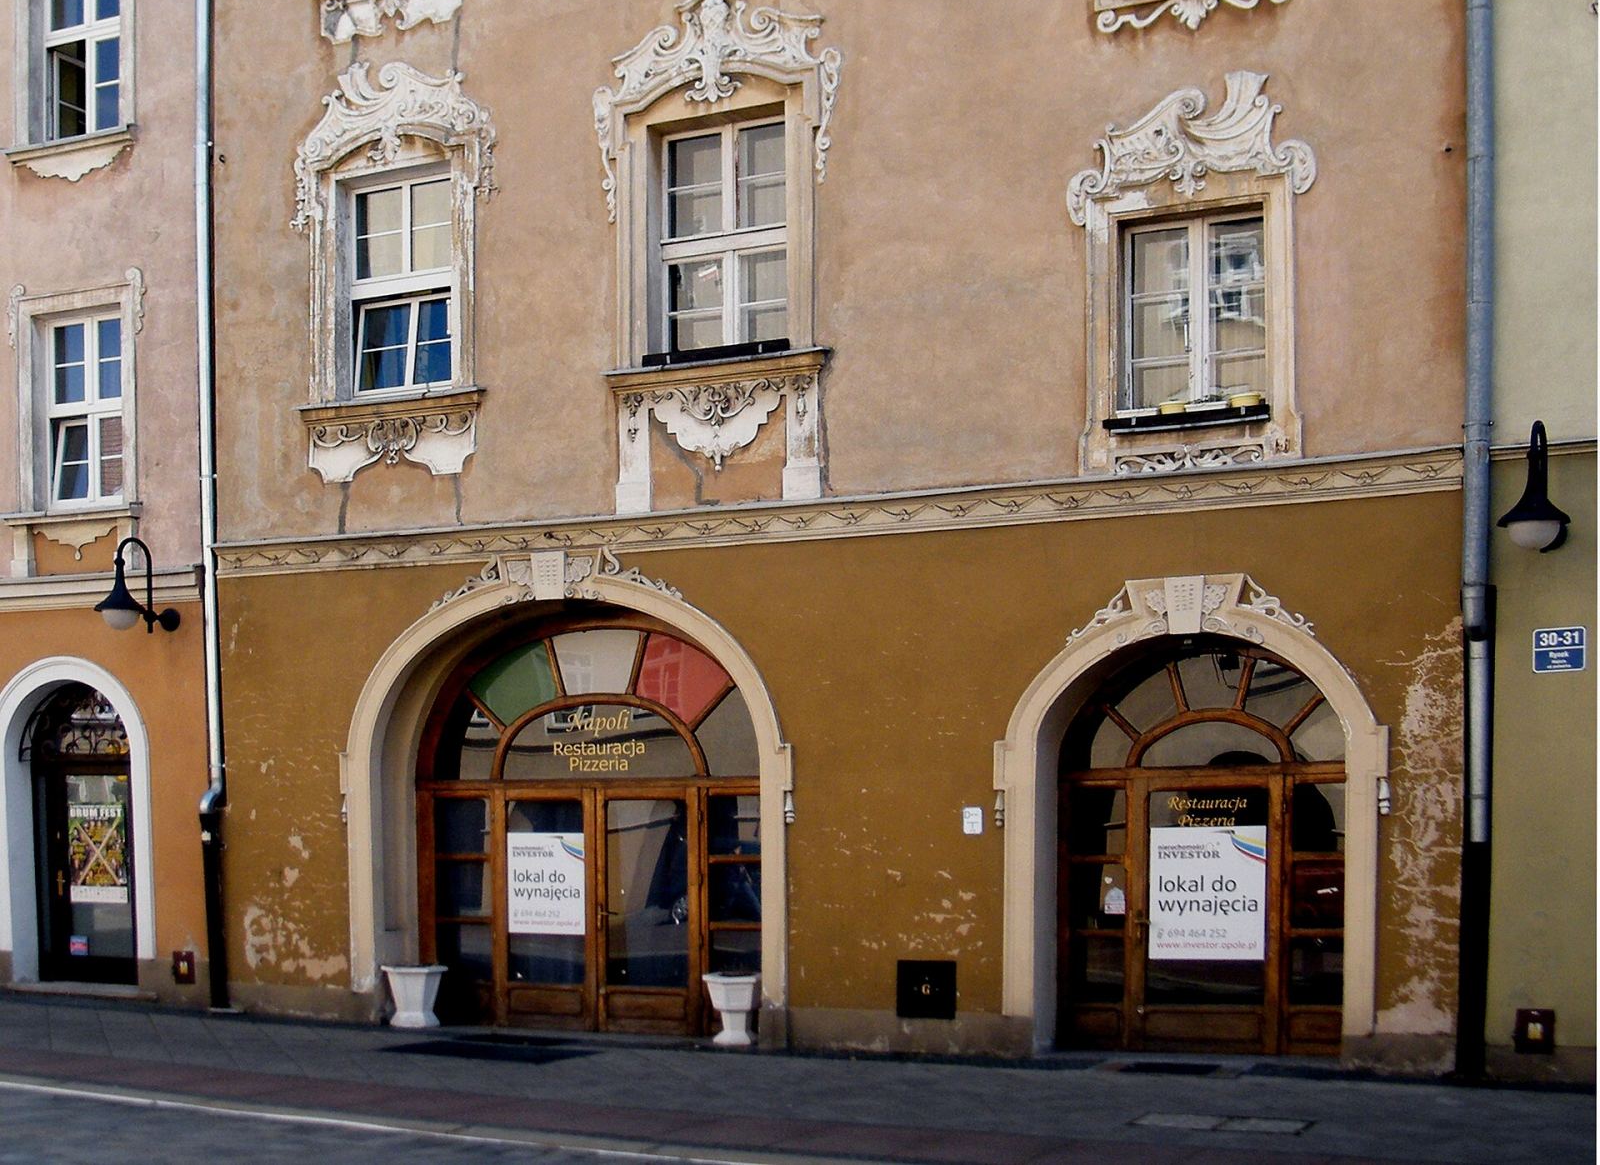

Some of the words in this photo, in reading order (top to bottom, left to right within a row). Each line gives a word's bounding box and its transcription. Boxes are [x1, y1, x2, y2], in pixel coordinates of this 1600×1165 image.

[1539, 631, 1579, 646] 30-31
[566, 709, 630, 737] Napoli
[553, 739, 645, 757] Restauracja
[569, 756, 628, 771] Pizzeria
[1167, 796, 1248, 813] Restauracja
[70, 808, 98, 818] DRUM
[100, 808, 122, 818] FEST
[1178, 814, 1236, 827] Pizzeria
[1157, 850, 1221, 860] INVESTOR
[513, 869, 544, 883] lokal
[549, 870, 566, 883] do
[1159, 875, 1204, 892] lokal
[1211, 875, 1237, 892] do
[513, 885, 581, 901] wynajęcia
[1158, 895, 1259, 916] wynajęcia
[1167, 928, 1186, 938] 694
[1188, 928, 1206, 938] 464
[1209, 928, 1228, 938] 252
[1157, 941, 1258, 951] www.investor.opole.pl
